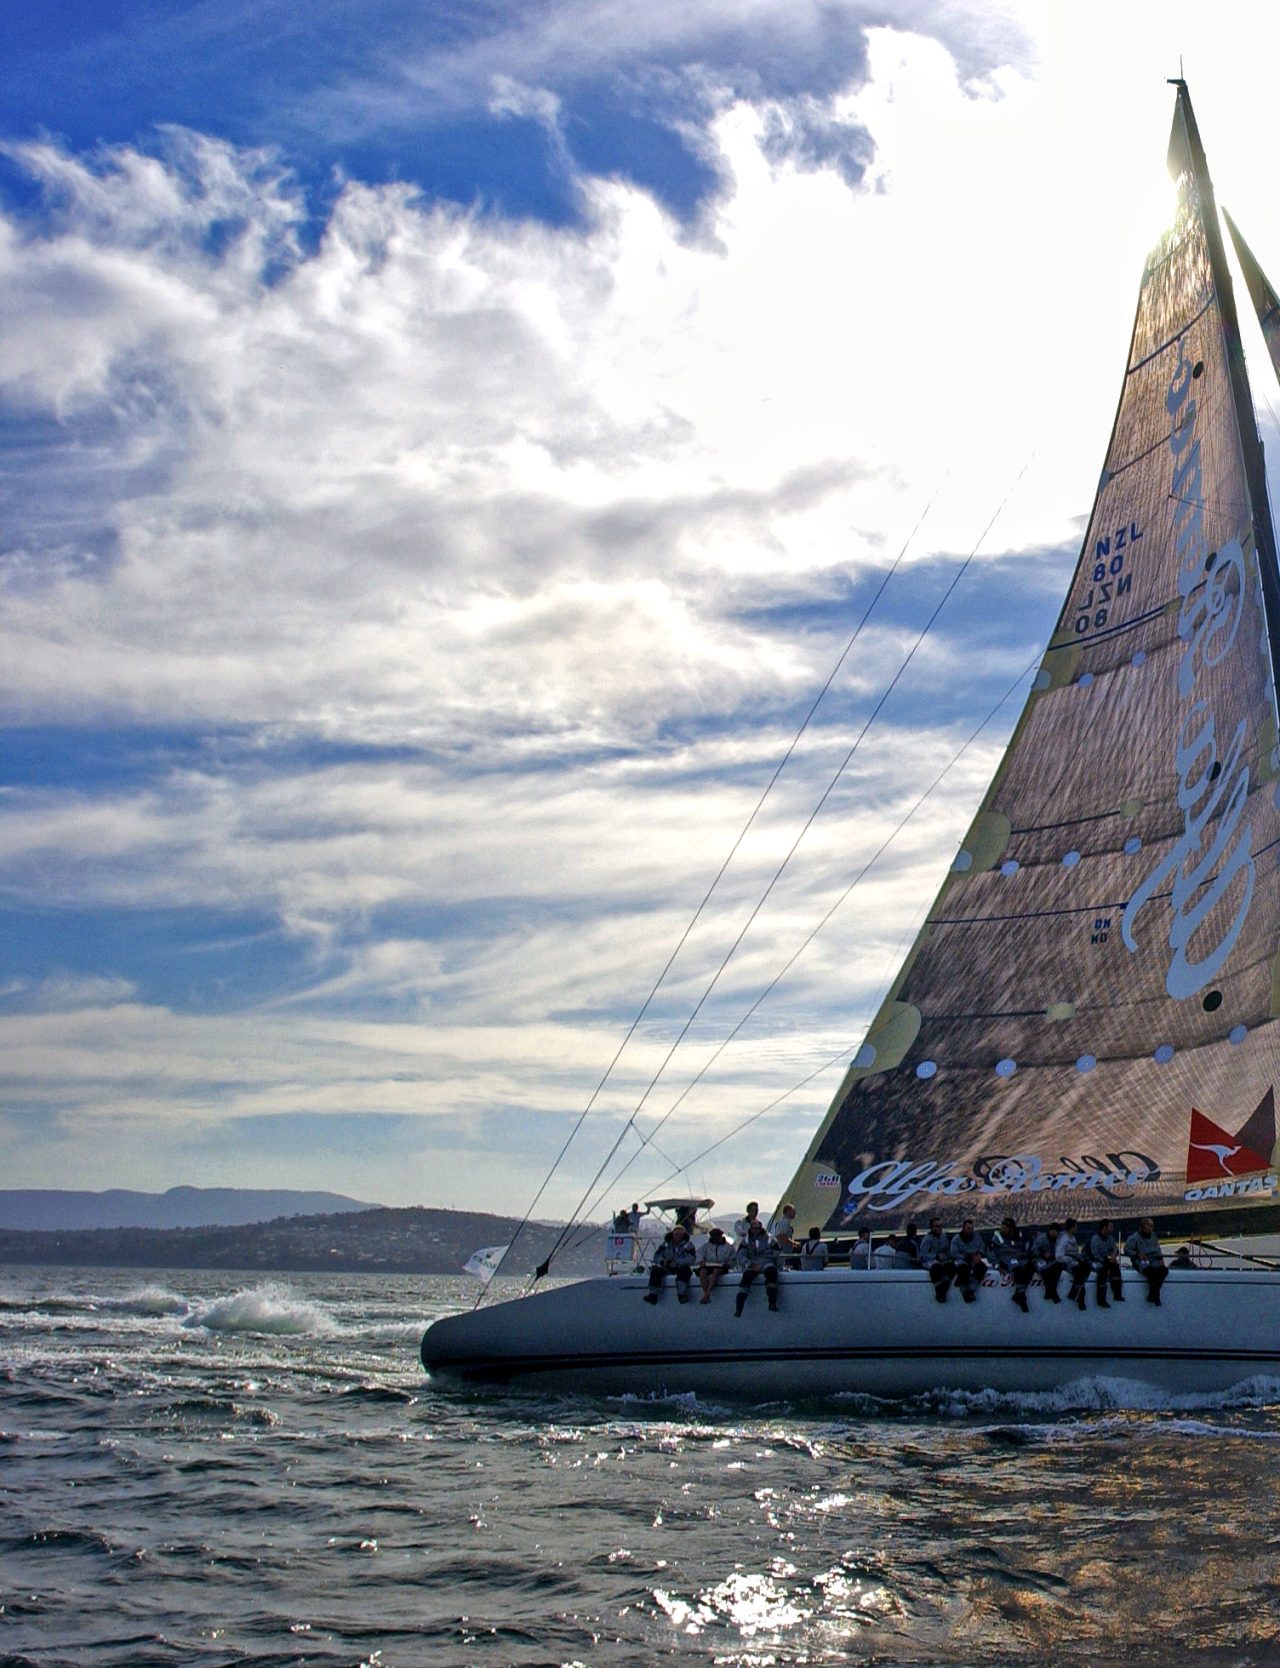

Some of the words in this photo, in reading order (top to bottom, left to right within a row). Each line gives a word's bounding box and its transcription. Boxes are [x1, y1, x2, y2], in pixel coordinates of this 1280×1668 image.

[1096, 522, 1143, 560] NZL
[848, 1160, 976, 1211] Alfa
[978, 1153, 1162, 1193] Romeo
[1184, 1175, 1279, 1201] QANTAS
